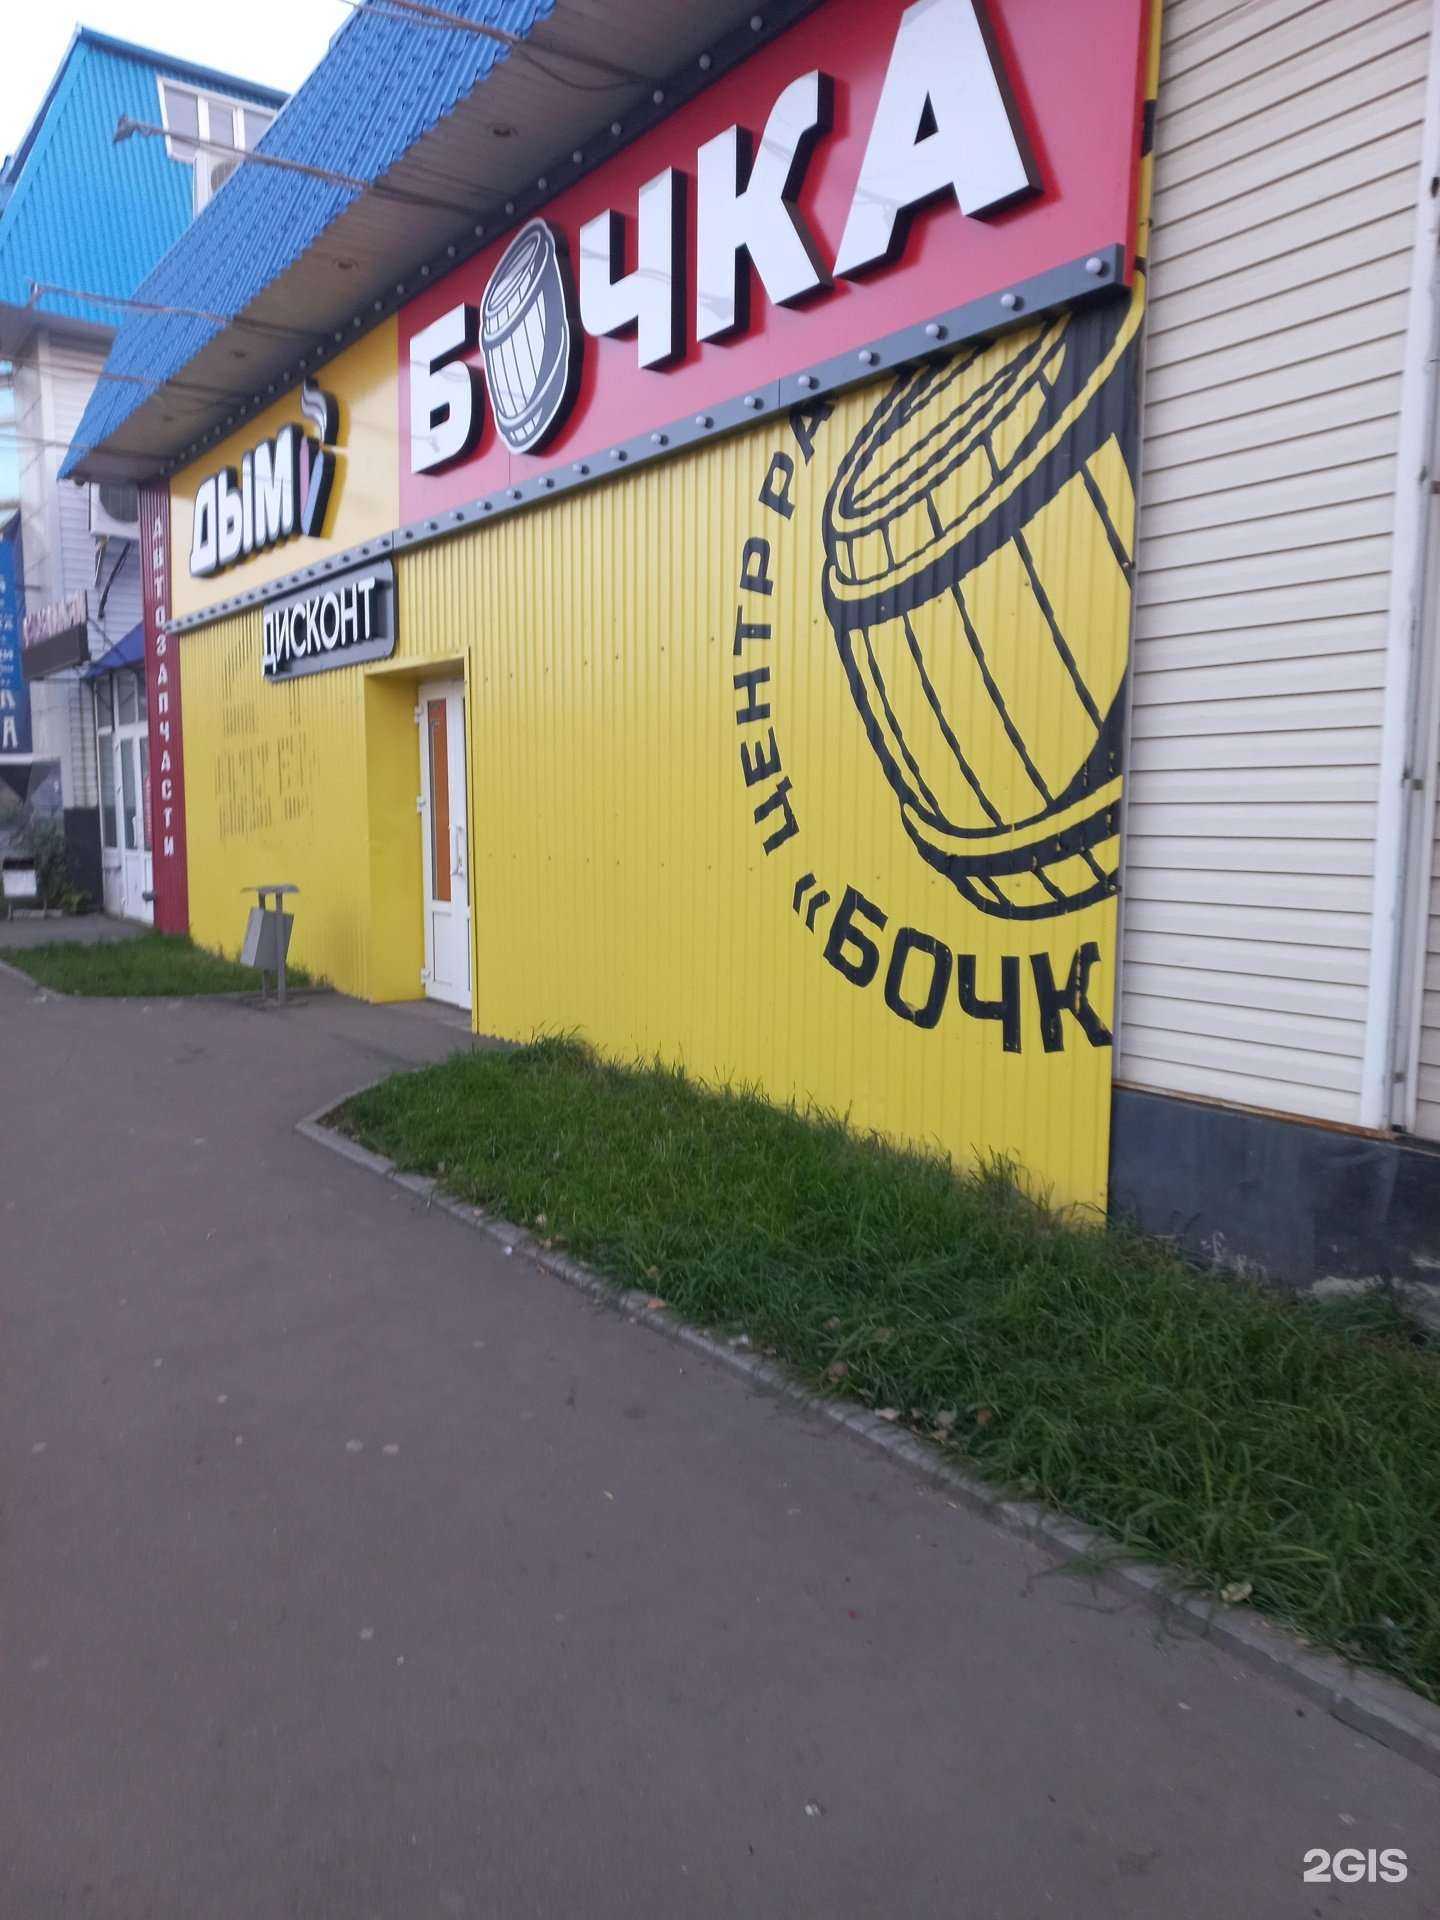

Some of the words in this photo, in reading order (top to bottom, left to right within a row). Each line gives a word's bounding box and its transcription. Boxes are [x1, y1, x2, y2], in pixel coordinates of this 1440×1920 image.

[151, 516, 175, 857] АВТОЗАПЧАСТИ
[261, 576, 375, 677] ДИСКОНТ
[733, 536, 800, 856] ЦЕНТР
